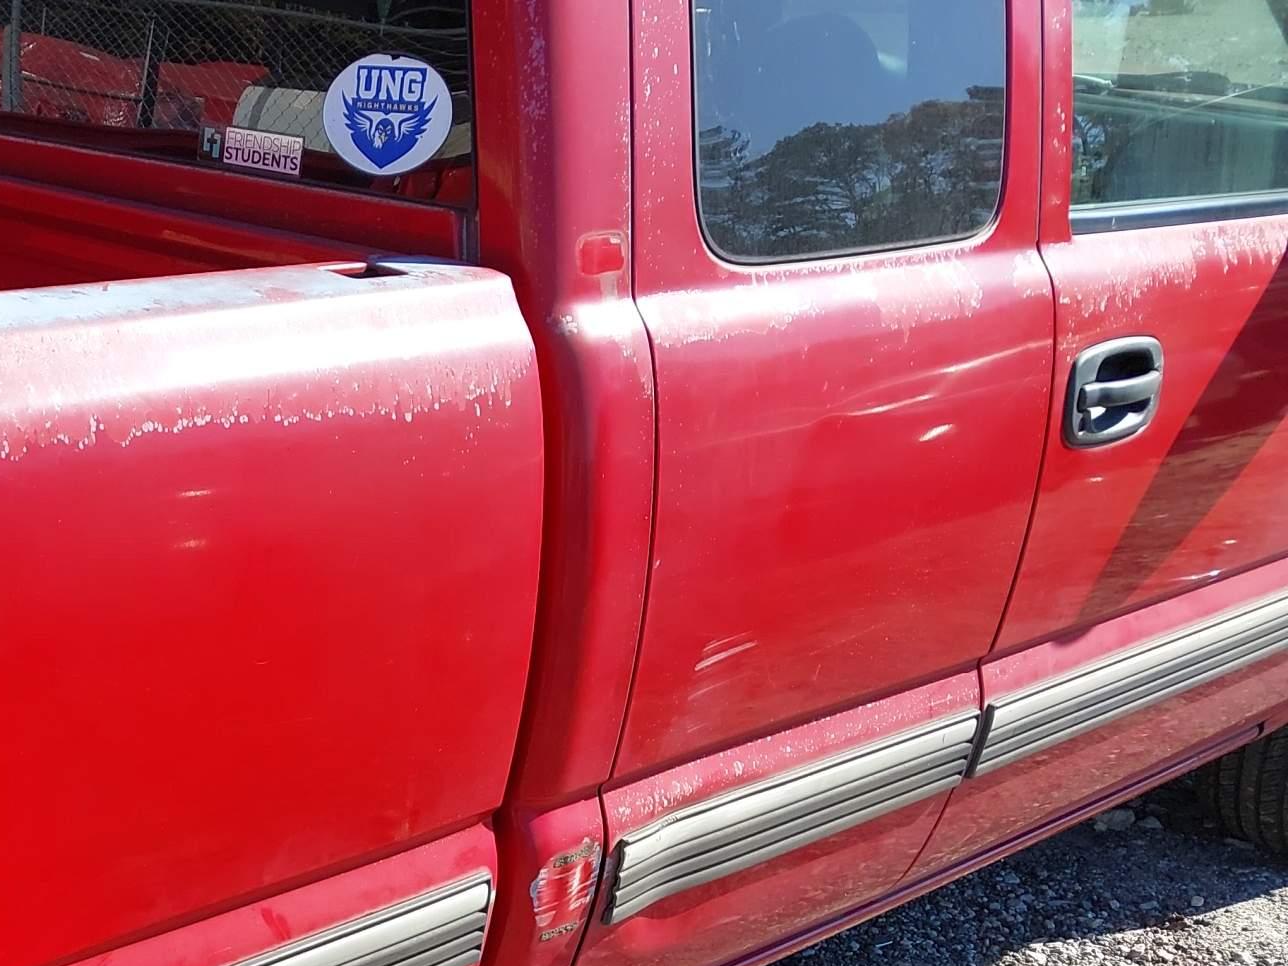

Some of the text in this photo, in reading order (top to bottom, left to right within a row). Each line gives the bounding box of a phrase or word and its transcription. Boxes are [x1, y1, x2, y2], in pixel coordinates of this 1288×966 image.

[358, 68, 423, 101] UNG
[357, 101, 419, 112] NIGHTHAWKS
[226, 130, 302, 154] FRIENDSHIP
[224, 146, 298, 171] STUDENTS
